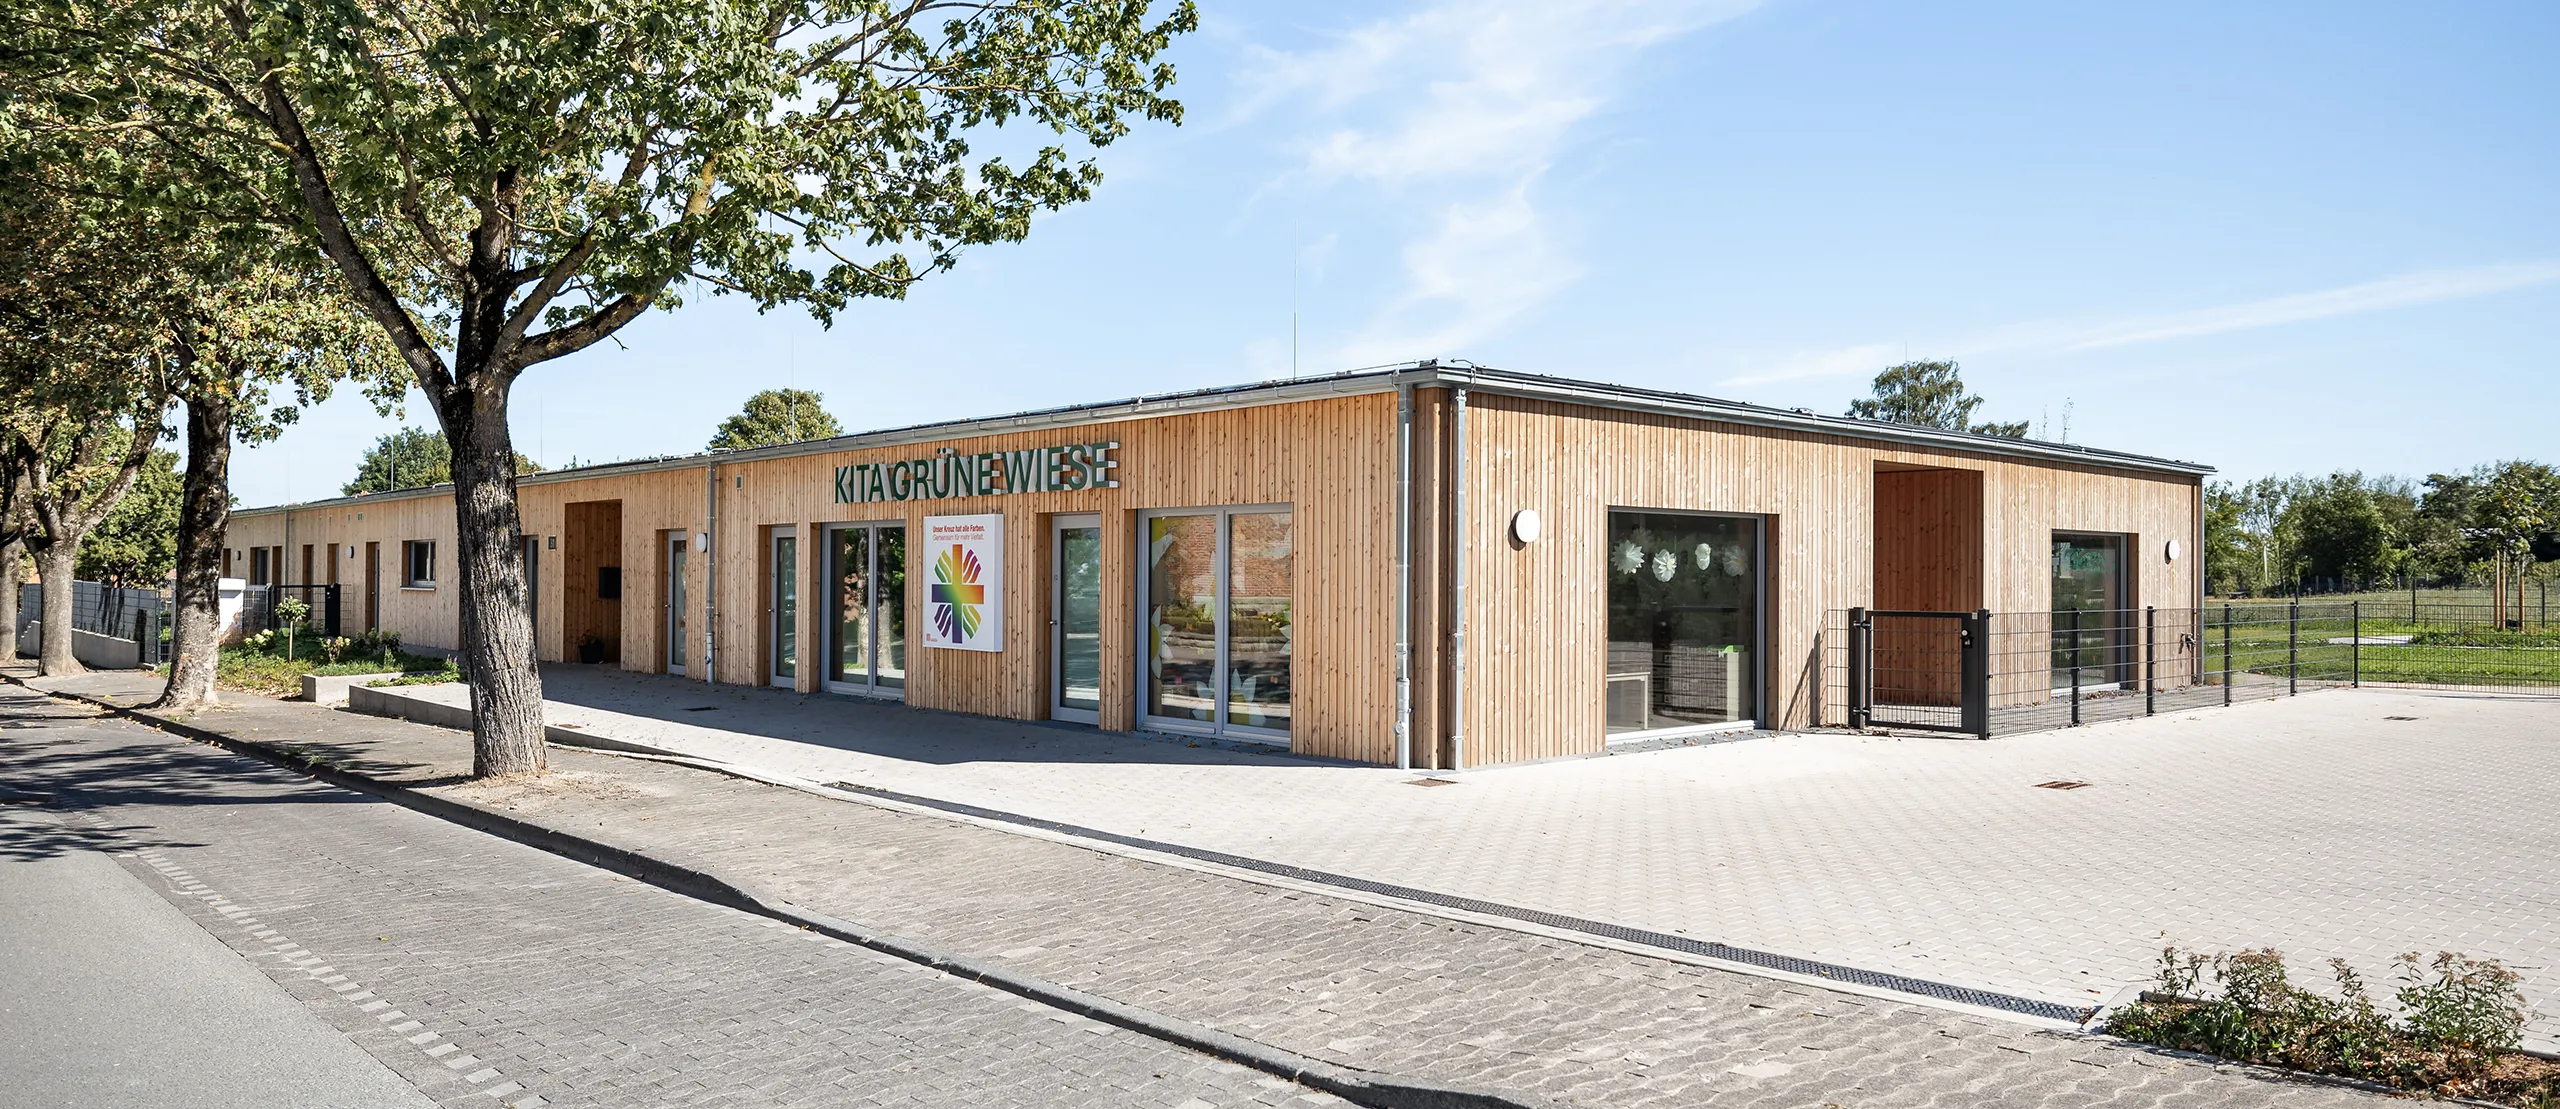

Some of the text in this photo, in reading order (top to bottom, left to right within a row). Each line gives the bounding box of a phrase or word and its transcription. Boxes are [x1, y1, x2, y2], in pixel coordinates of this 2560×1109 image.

[834, 441, 1115, 504] KITA GRÜNE WIESE
